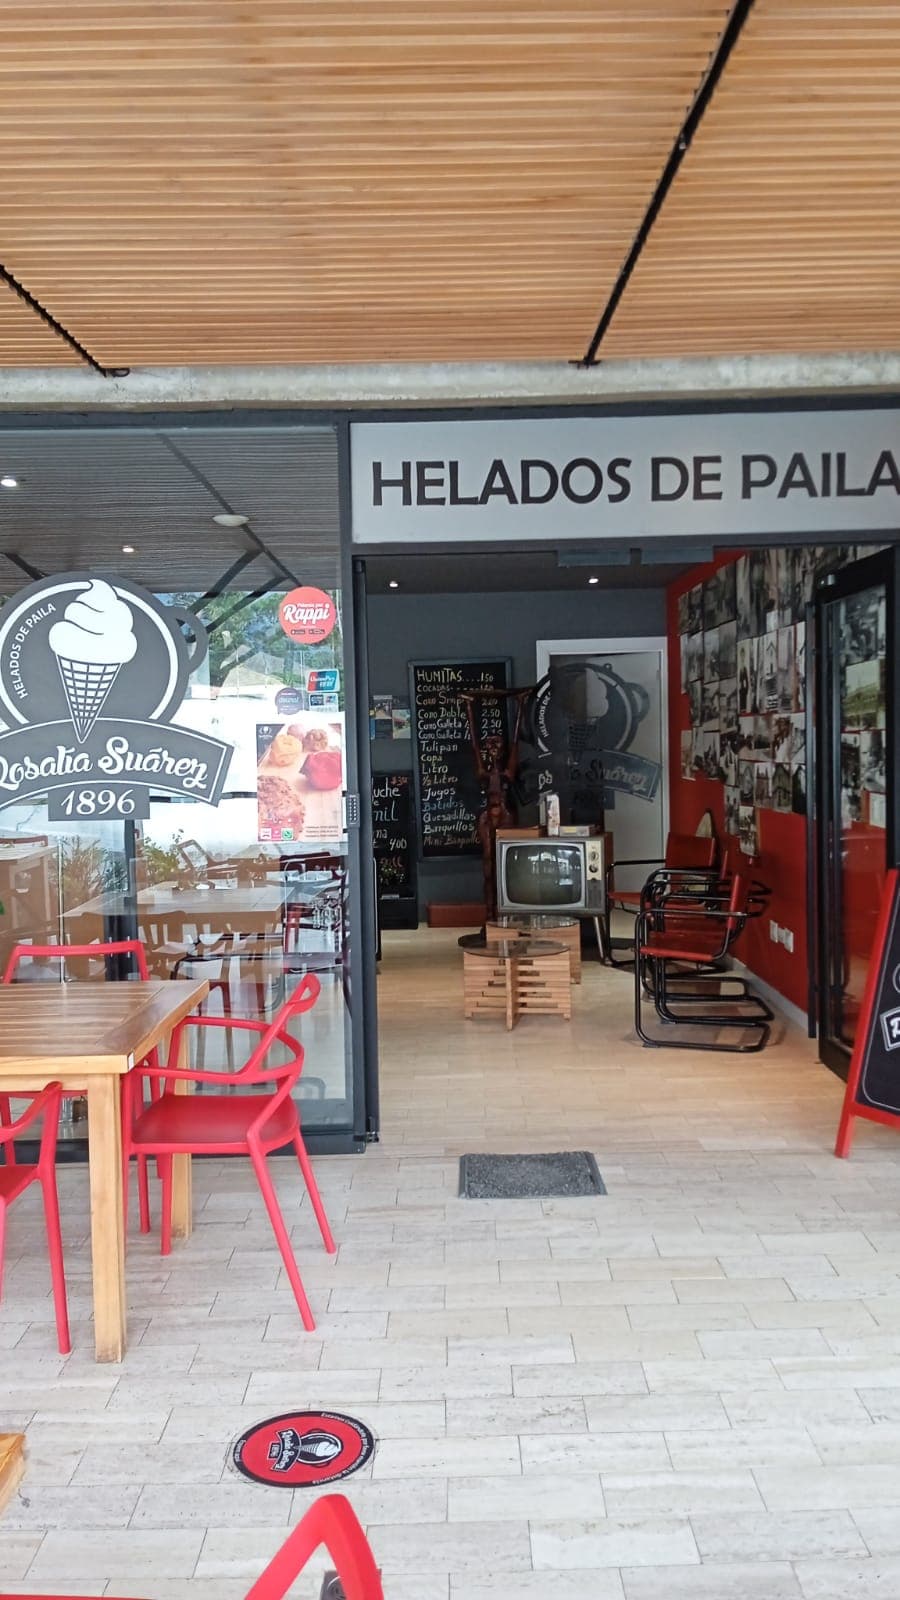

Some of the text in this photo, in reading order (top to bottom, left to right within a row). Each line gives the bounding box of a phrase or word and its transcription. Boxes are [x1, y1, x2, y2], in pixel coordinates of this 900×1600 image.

[372, 450, 900, 507] HELADOS DE PAILA
[283, 602, 330, 625] Rappi
[9, 602, 57, 699] HELADOS DE PAILA
[438, 691, 466, 706] Simp
[418, 709, 438, 719] Cono
[440, 706, 467, 719] Doble
[98, 736, 208, 789] Suárez
[422, 763, 448, 774] Litro
[60, 788, 136, 816] 1896
[422, 787, 456, 802] Jugos
